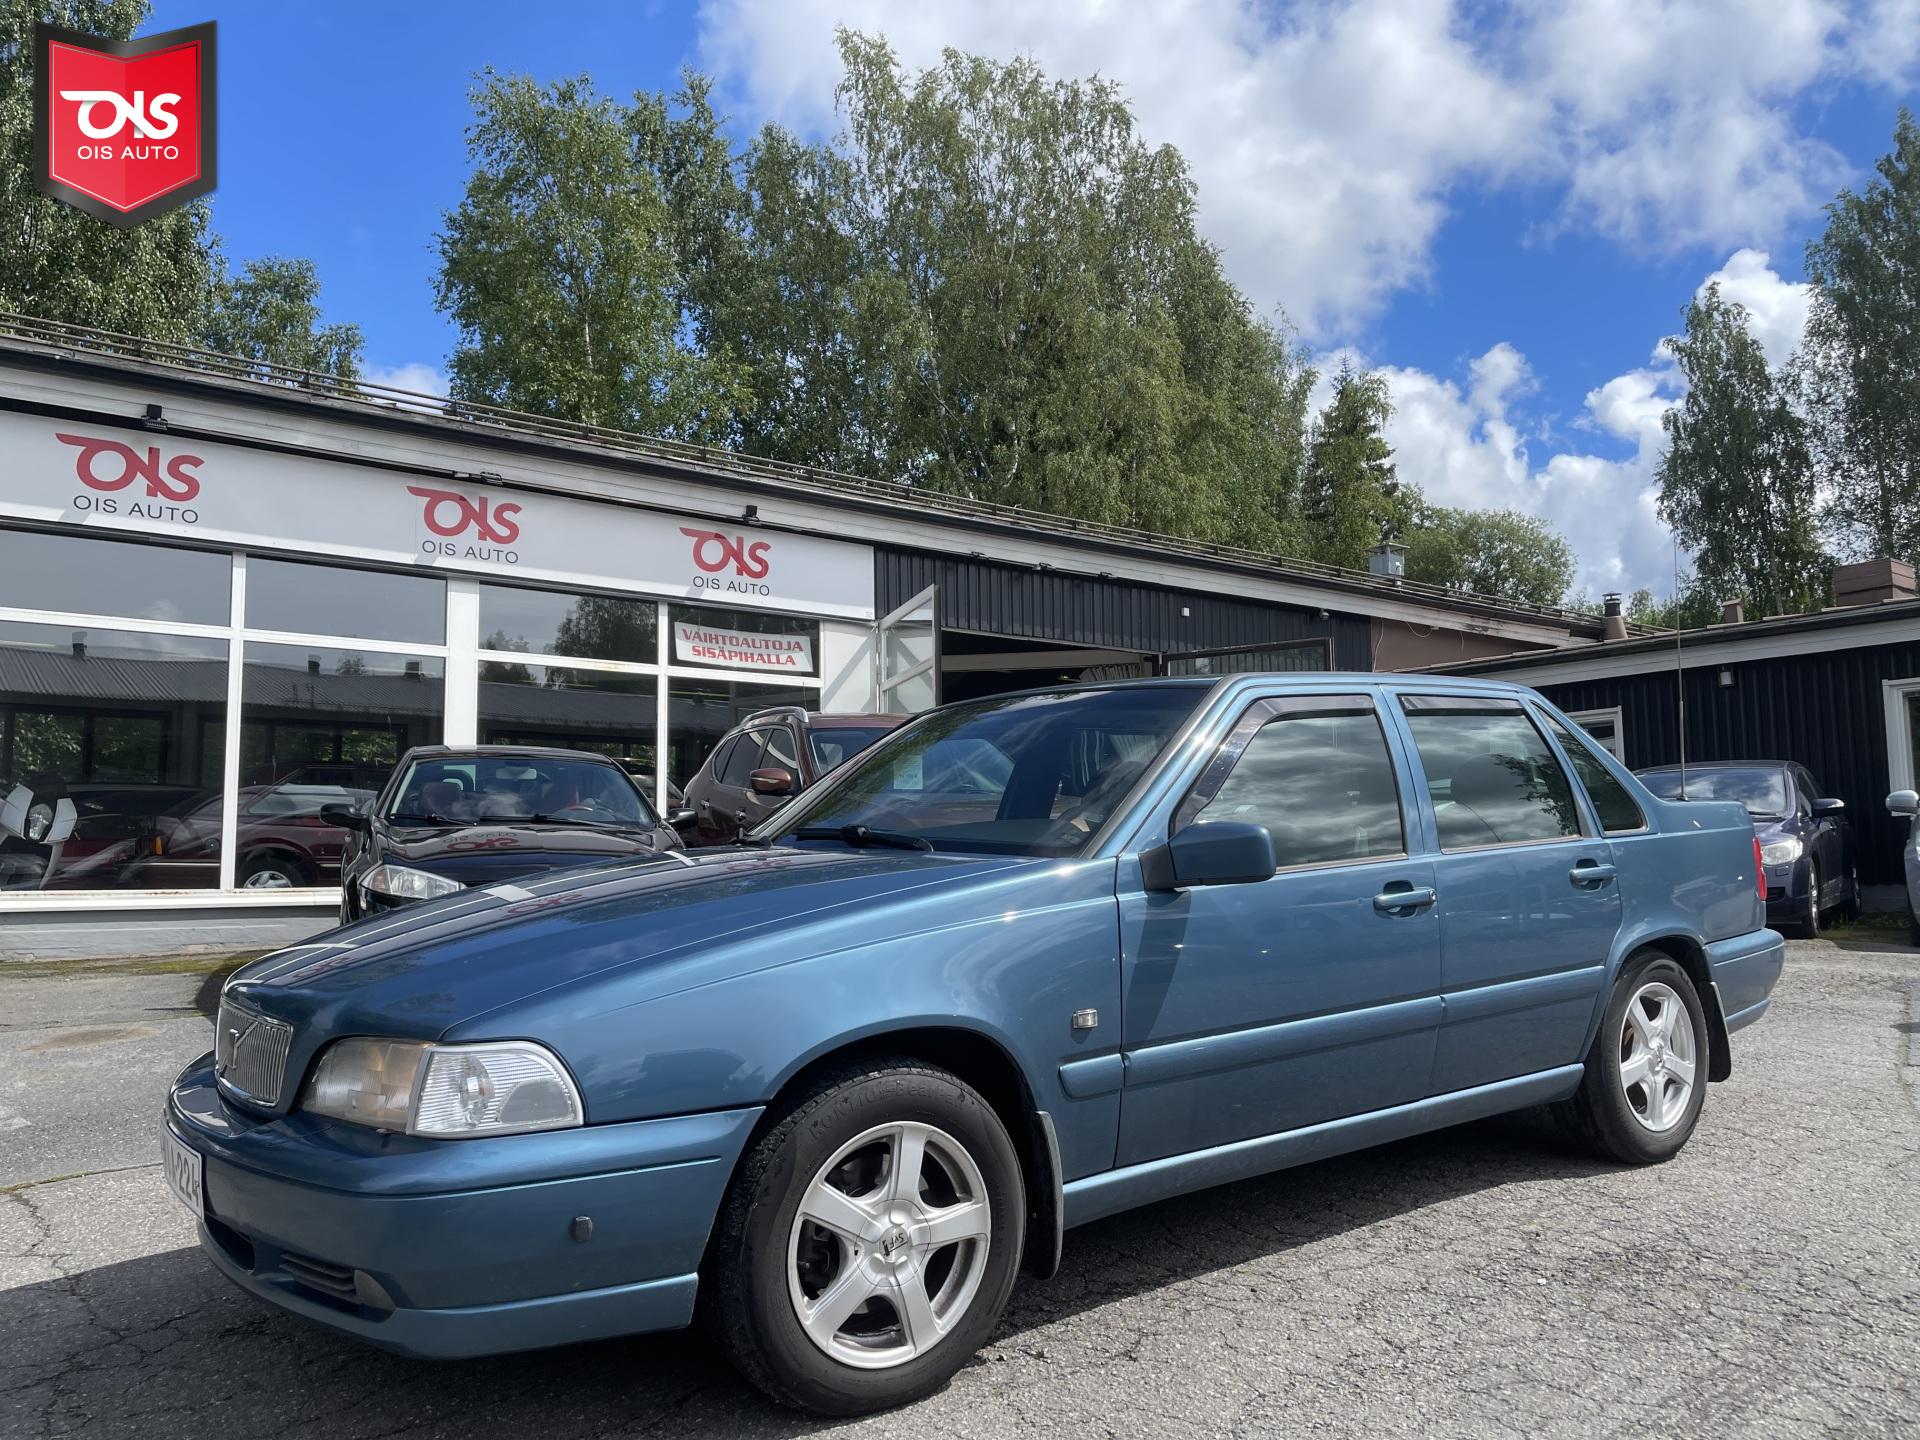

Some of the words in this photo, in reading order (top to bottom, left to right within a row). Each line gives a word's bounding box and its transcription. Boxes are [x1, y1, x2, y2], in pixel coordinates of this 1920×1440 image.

[74, 496, 117, 514] OIS
[129, 503, 199, 524] AUTO
[422, 540, 456, 556] OIS
[464, 546, 518, 564] AUTO
[693, 576, 720, 590] OIS
[727, 581, 770, 596] AUTO
[682, 628, 803, 652] VAIHTOAUTOJA
[691, 645, 796, 665] SISÄPIHALLA
